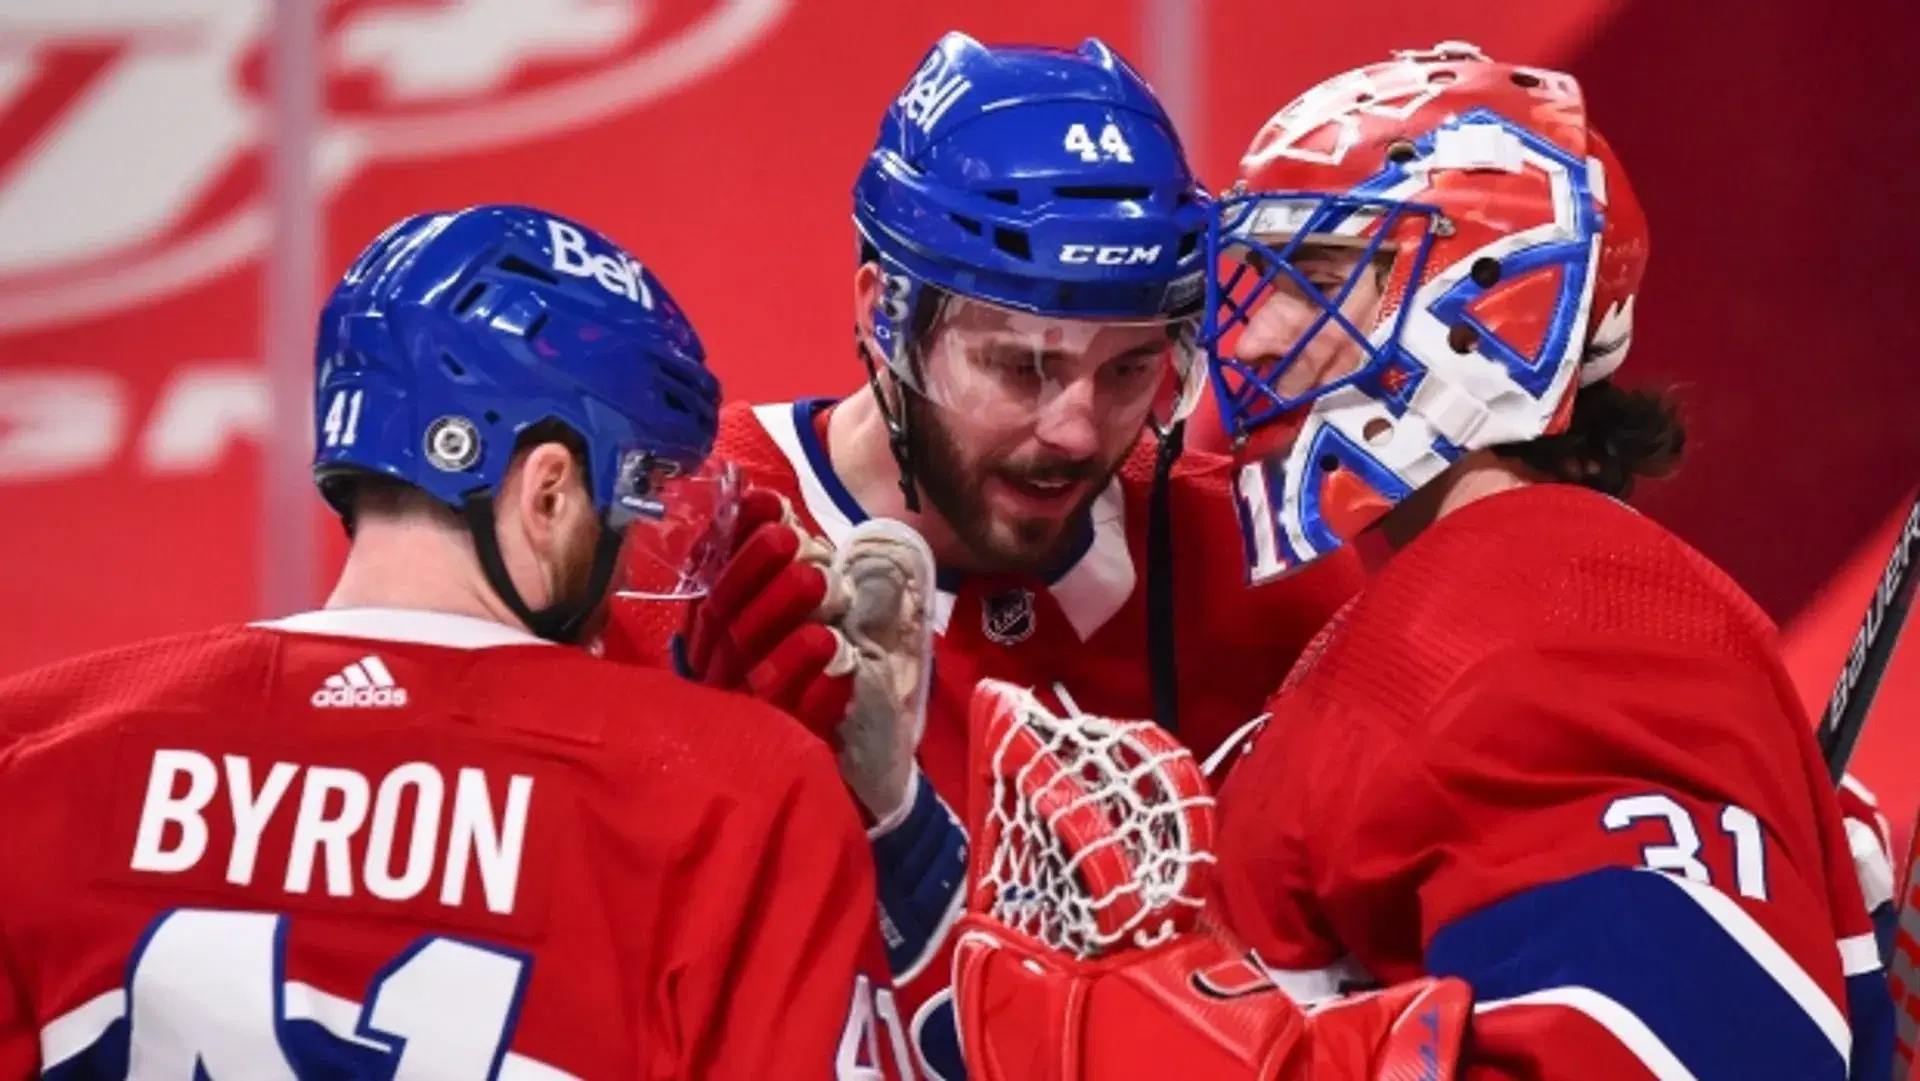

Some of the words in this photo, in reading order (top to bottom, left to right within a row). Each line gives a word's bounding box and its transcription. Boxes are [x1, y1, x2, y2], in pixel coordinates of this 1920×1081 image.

[897, 48, 974, 135] Bell
[1063, 123, 1135, 163] 44
[547, 219, 656, 311] Bell
[1058, 244, 1163, 266] CCM
[323, 390, 364, 448] 41
[311, 687, 408, 708] adidas
[129, 749, 535, 915] BYRON
[1601, 791, 1770, 902] 31
[834, 973, 917, 1081] 41
